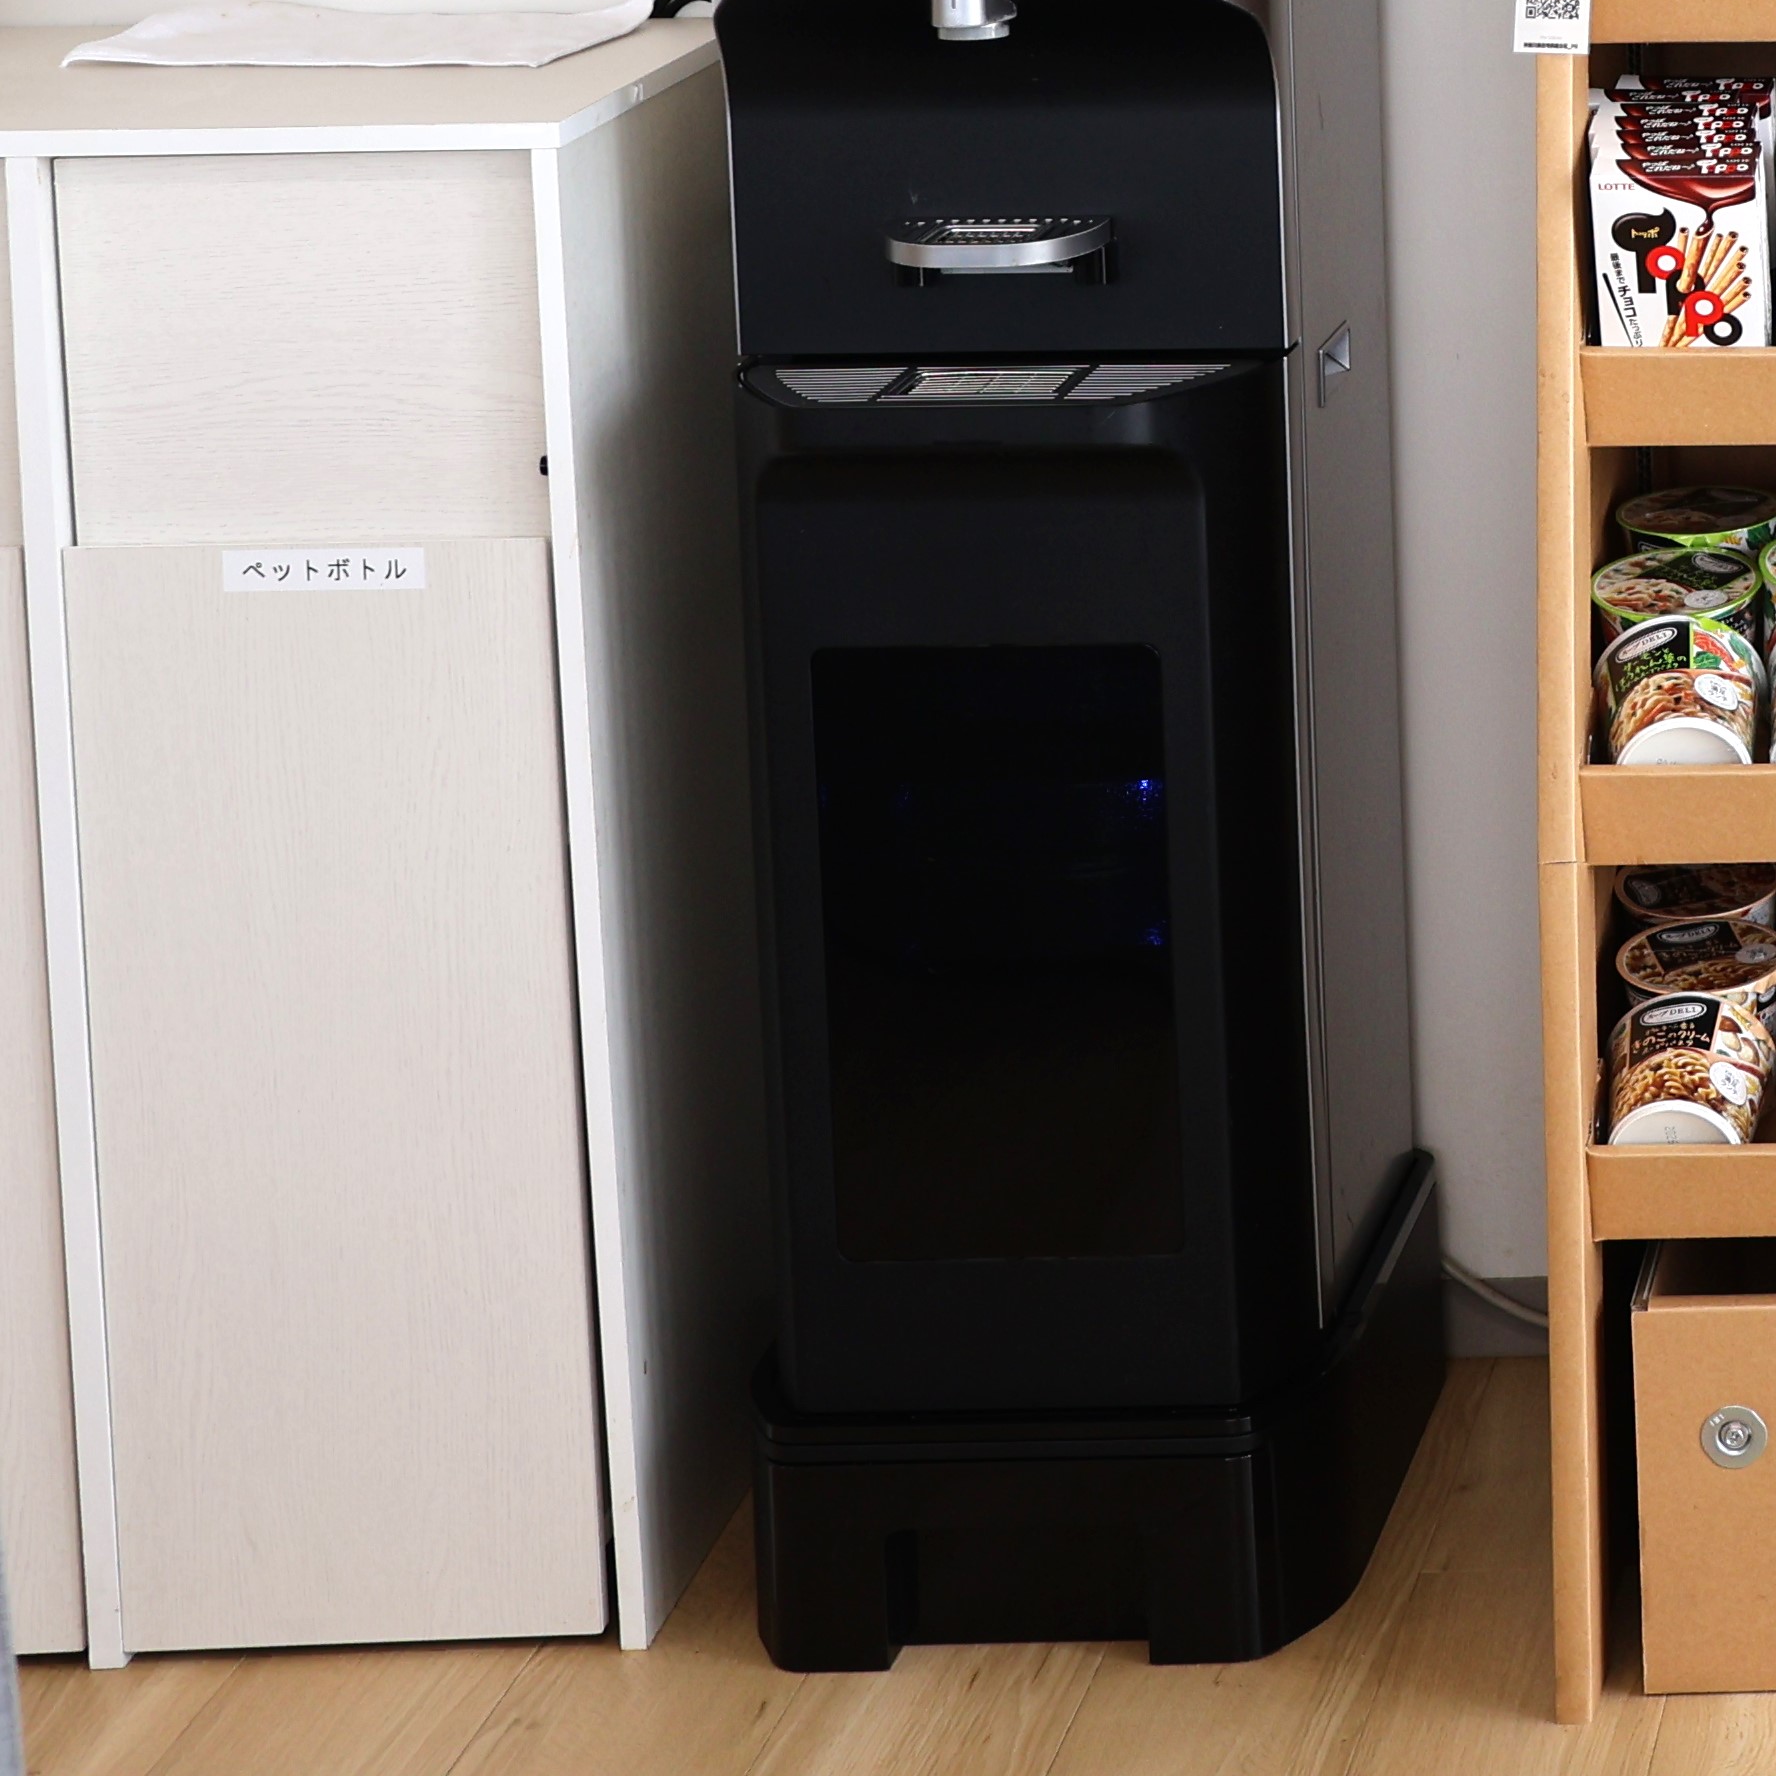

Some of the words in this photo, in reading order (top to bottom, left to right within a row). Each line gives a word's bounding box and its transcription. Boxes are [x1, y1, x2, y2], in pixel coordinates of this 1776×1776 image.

[1599, 183, 1635, 191] LOTTE
[242, 559, 407, 581] ペットボトル
